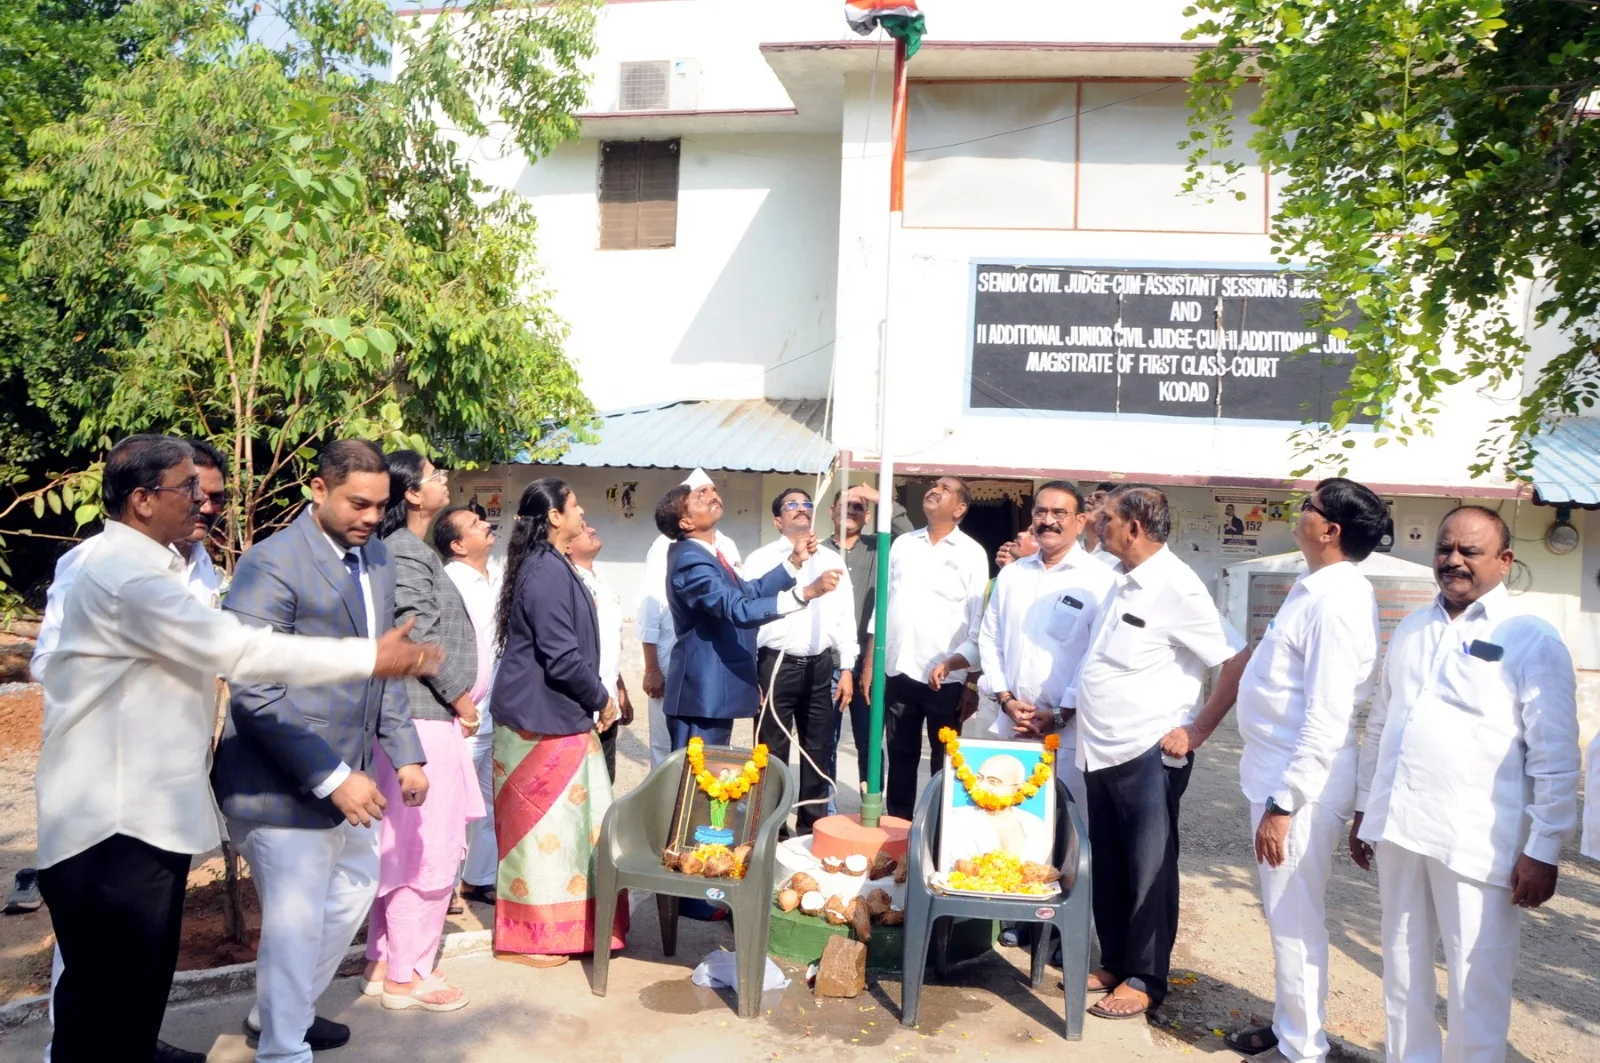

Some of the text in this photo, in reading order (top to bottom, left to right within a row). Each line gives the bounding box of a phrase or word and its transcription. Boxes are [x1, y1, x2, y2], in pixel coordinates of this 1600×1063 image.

[978, 272, 1028, 293] SENIOR
[1030, 273, 1062, 293] CIVIL
[1064, 273, 1220, 296] JUDGE-CUM-ASSISTANT
[1222, 276, 1287, 298] SESSIONS
[1169, 300, 1202, 322] AND
[976, 323, 987, 344] II
[988, 324, 1064, 346] ADDITIONAL
[1065, 326, 1113, 347] JUNIOR
[1114, 327, 1146, 348] CIVIL
[1239, 331, 1321, 353] ADDITIONAL
[1026, 351, 1279, 378] MAGISTRATE OF FIRST CLASS COURT
[1159, 381, 1209, 402] KODAD
[1245, 521, 1262, 531] 152
